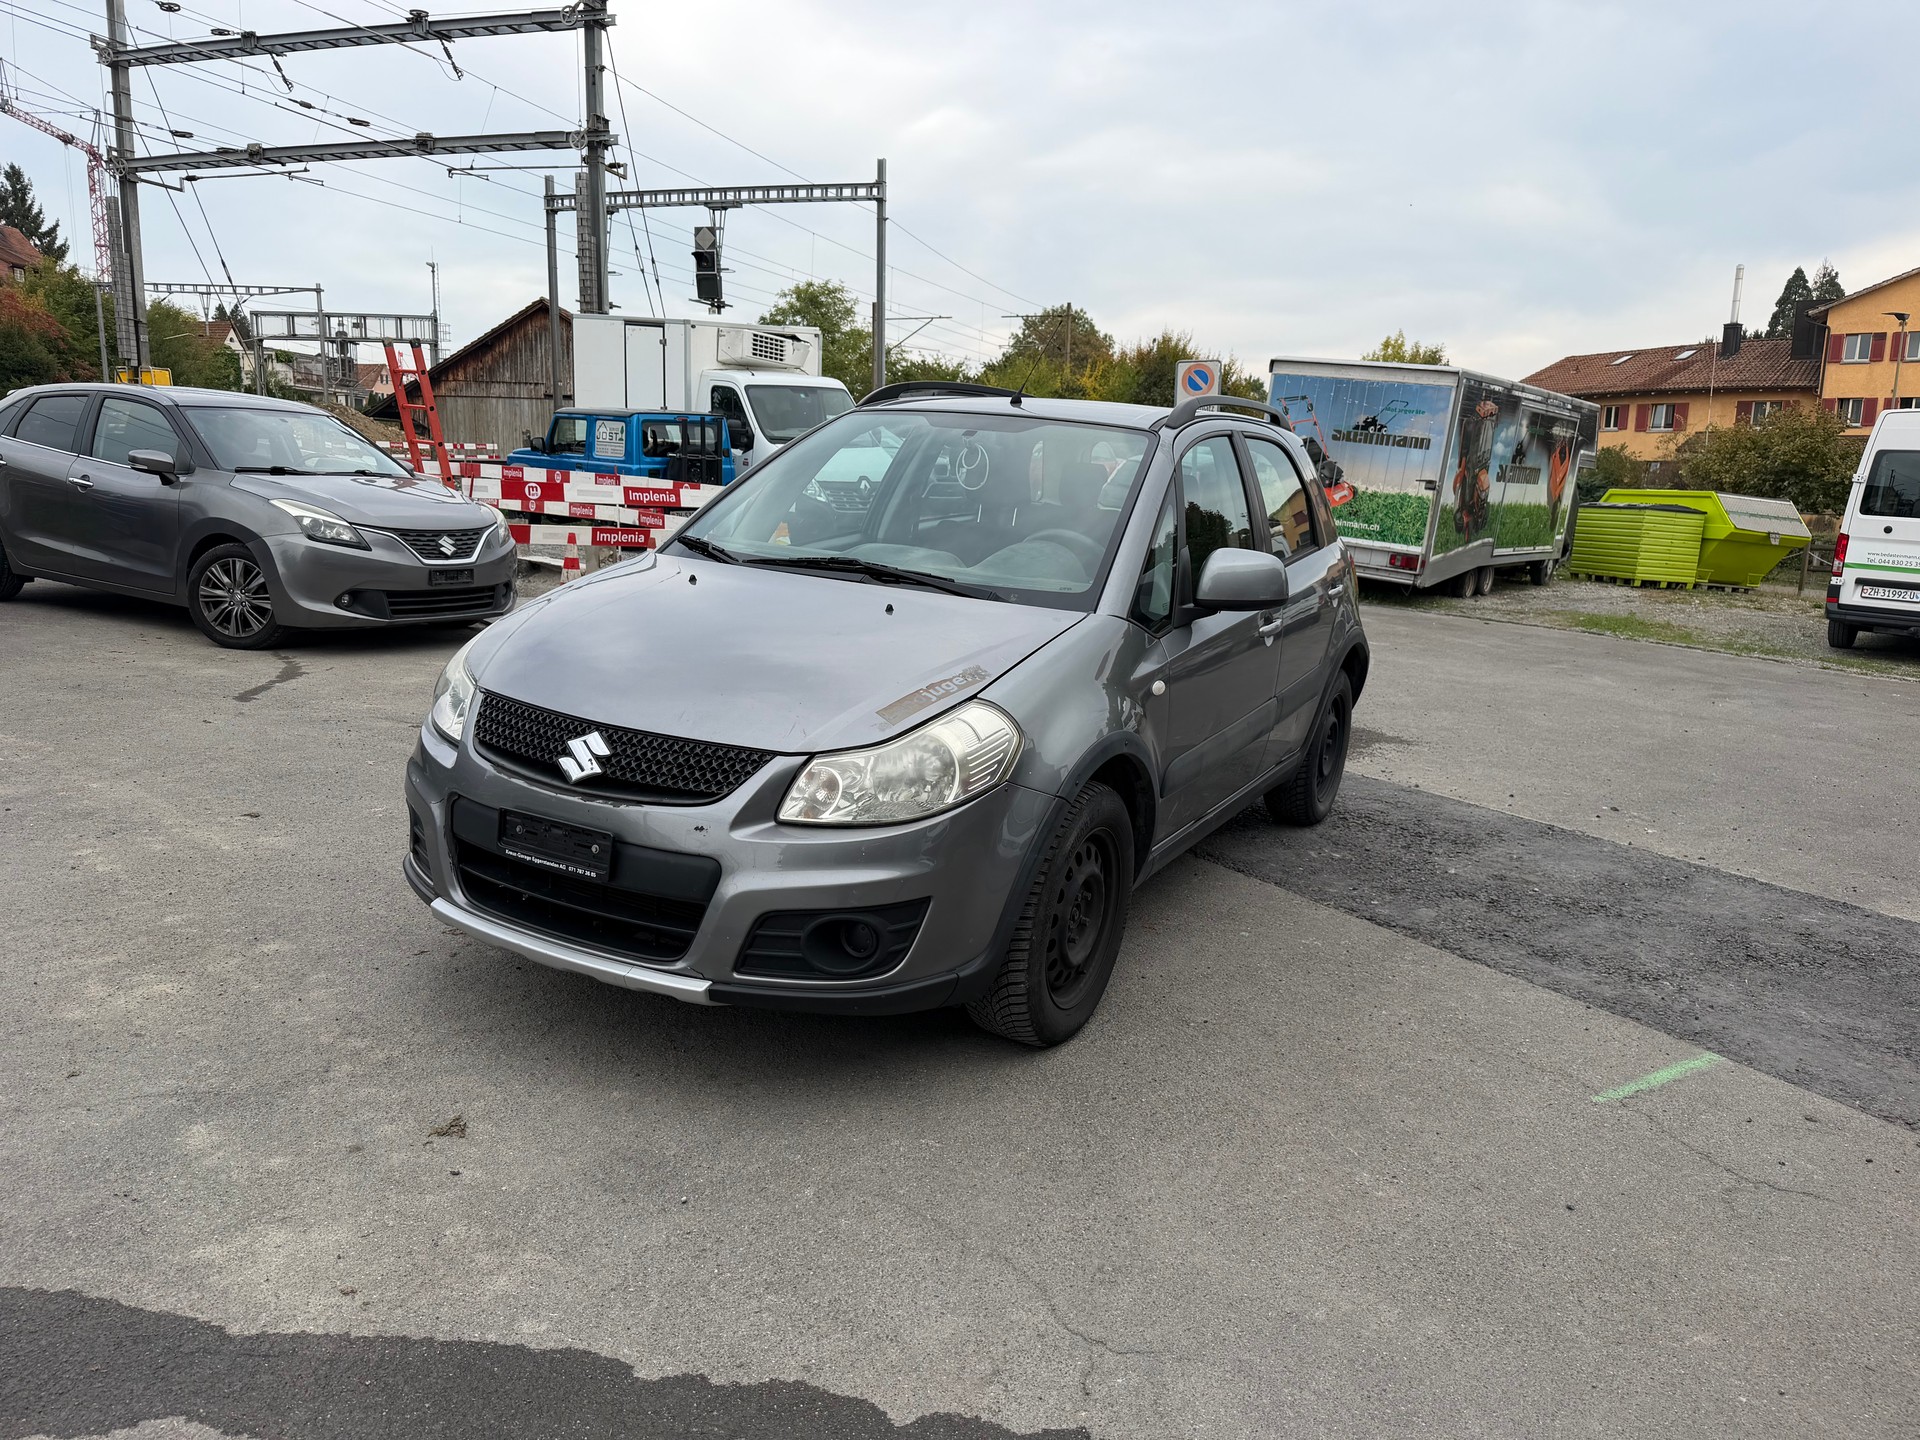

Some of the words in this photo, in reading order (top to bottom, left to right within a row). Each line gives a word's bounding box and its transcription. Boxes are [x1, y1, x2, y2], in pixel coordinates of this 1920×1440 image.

[596, 431, 619, 441] JOST
[628, 489, 676, 504] Implenia
[570, 505, 593, 516] Implenia
[640, 513, 663, 526] Implenia
[1333, 518, 1380, 531] einmann.ch
[596, 530, 645, 545] Implenia
